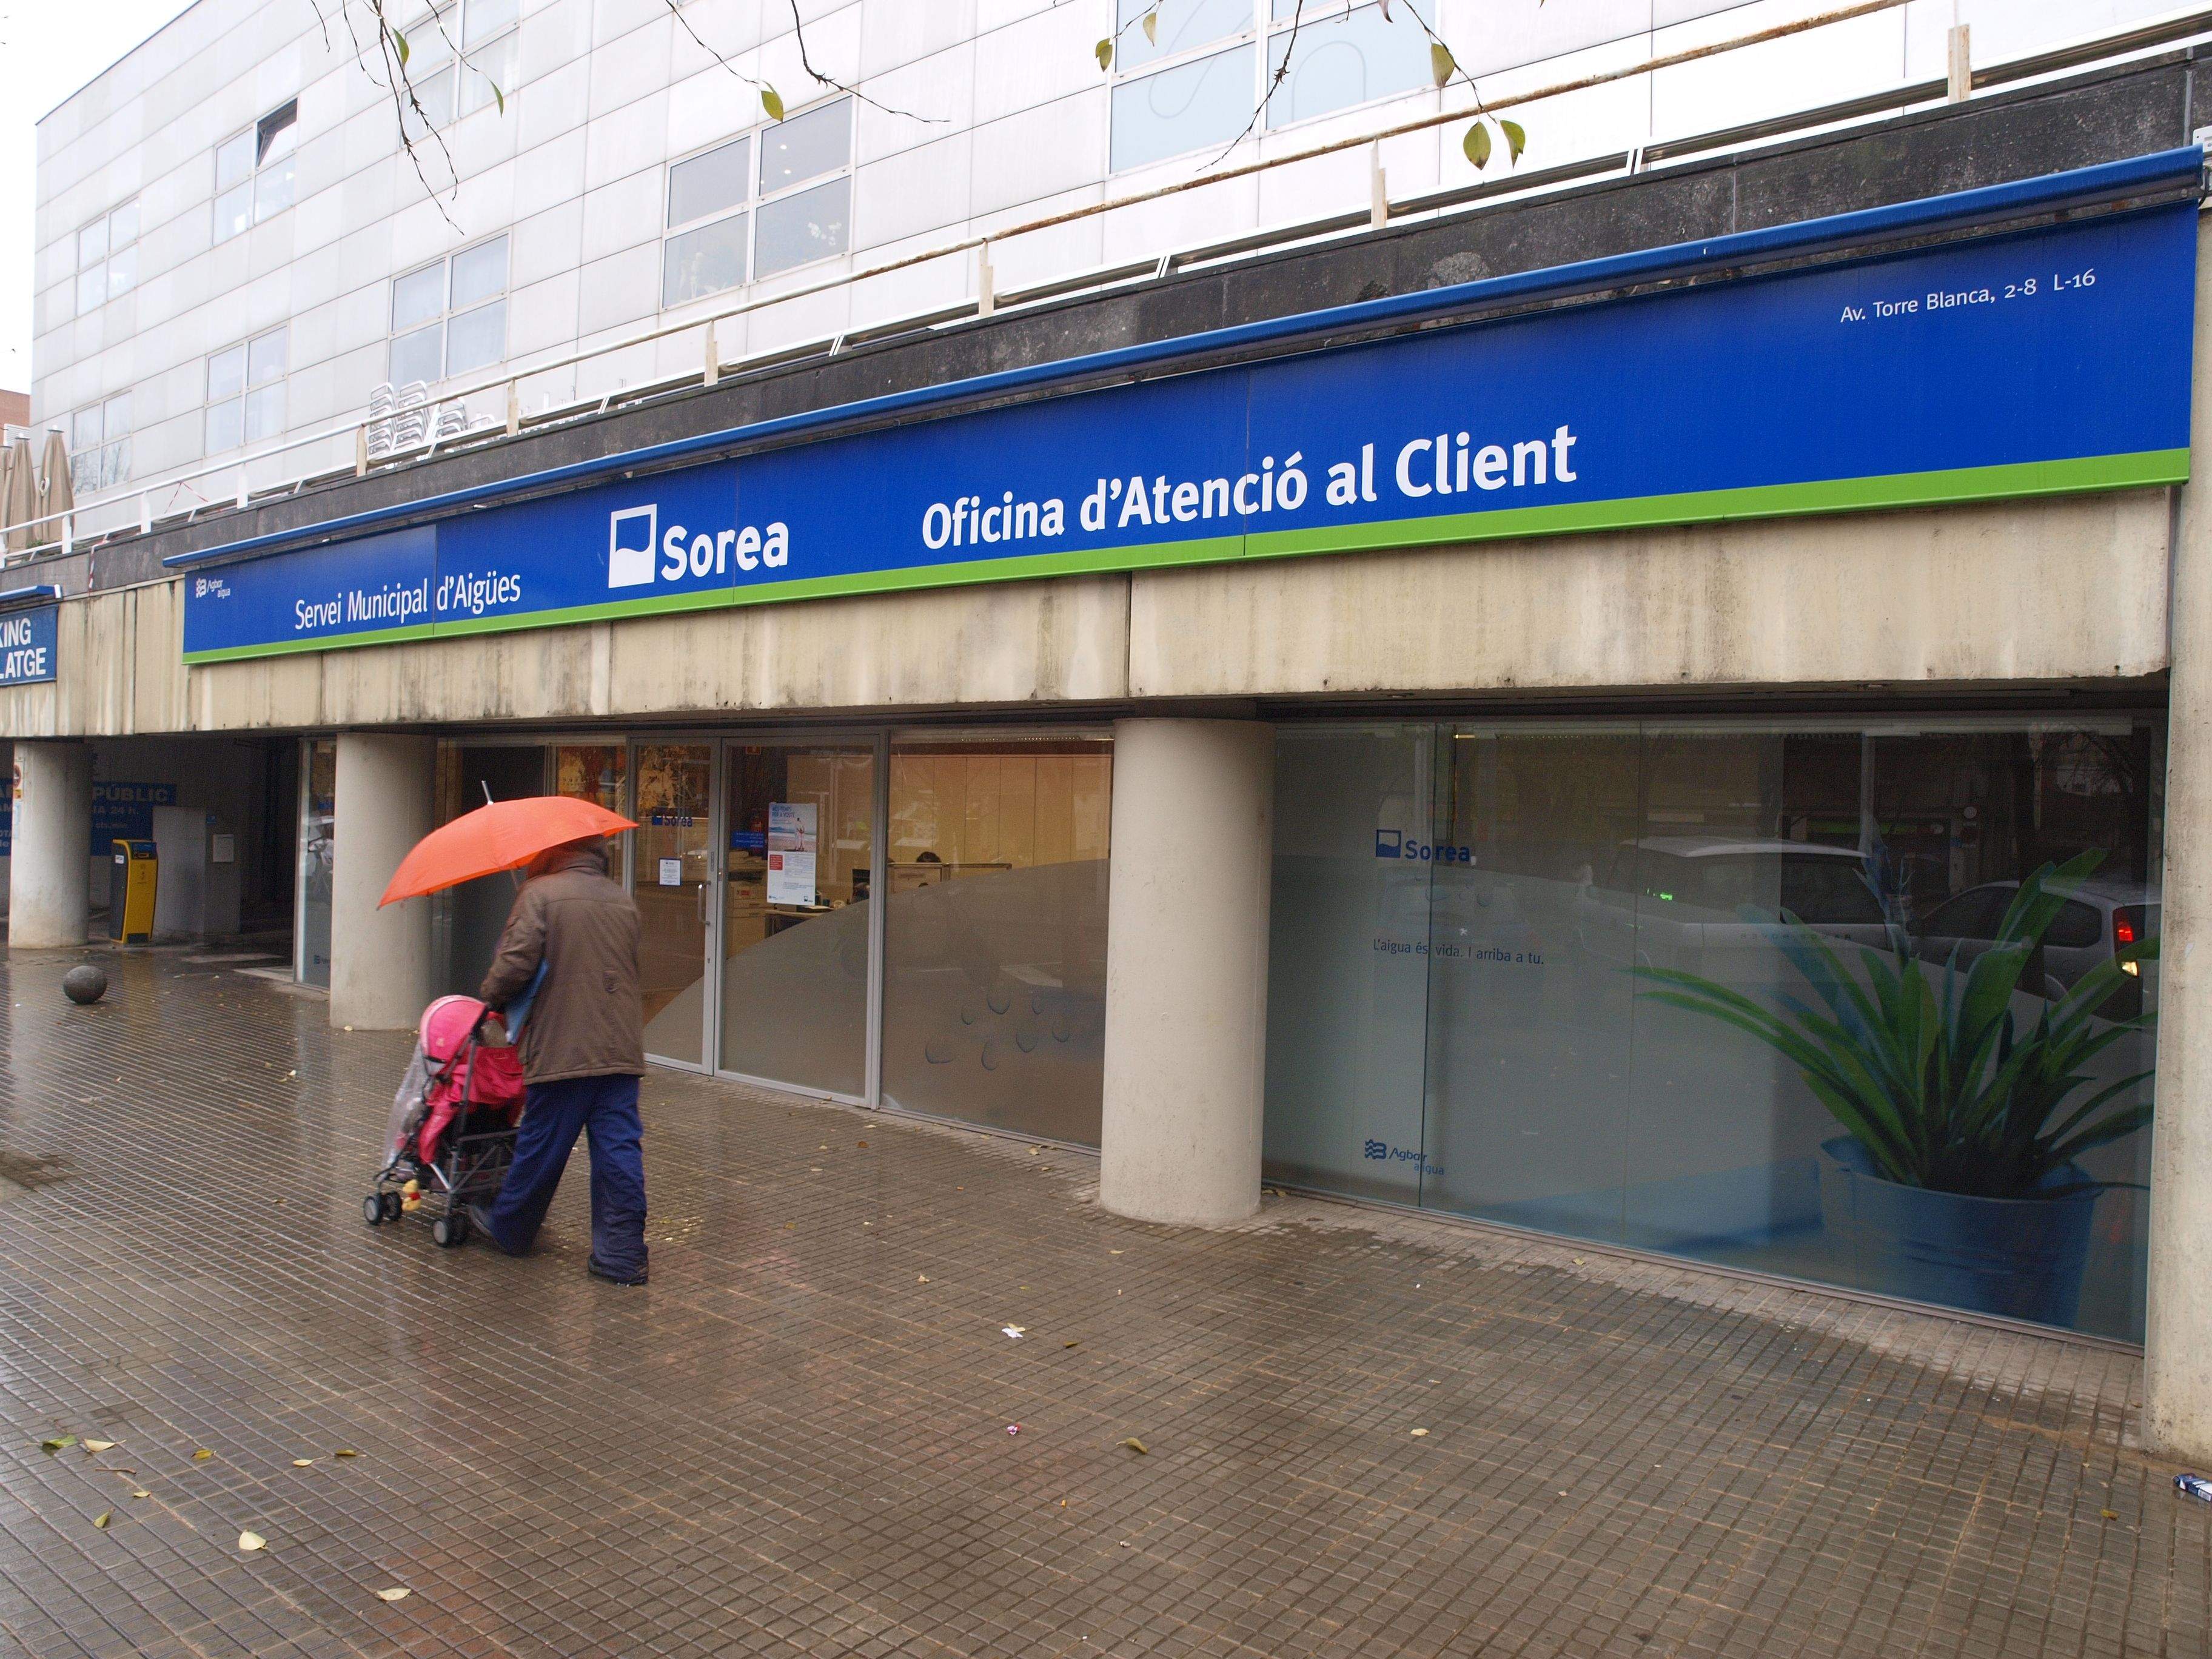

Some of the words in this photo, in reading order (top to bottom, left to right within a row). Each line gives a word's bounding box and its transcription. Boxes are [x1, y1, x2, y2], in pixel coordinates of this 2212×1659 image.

[1840, 306, 1866, 323] Av.
[1872, 300, 1919, 318] Torre
[1926, 289, 1996, 310] Blanca,
[2004, 278, 2037, 298] 2-8
[2054, 268, 2096, 291] L-16
[922, 491, 1065, 549] Oficina
[1080, 451, 1307, 532] d'Atenció
[1326, 443, 1378, 506] al
[1395, 424, 1577, 498] Client
[661, 521, 789, 581] Sorea
[207, 579, 223, 592] Agbar
[295, 592, 341, 630] Servei
[347, 577, 428, 624] Municipal
[92, 783, 169, 802] PÚBLIC
[1404, 839, 1471, 863] Sorea
[1415, 942, 1429, 955] és
[1435, 943, 1463, 958] vida.
[1476, 947, 1511, 963] arriba
[1516, 953, 1523, 963] a
[1528, 952, 1544, 965] tu.
[1389, 1147, 1428, 1162] Agbar
[1413, 1163, 1444, 1176] aigua
